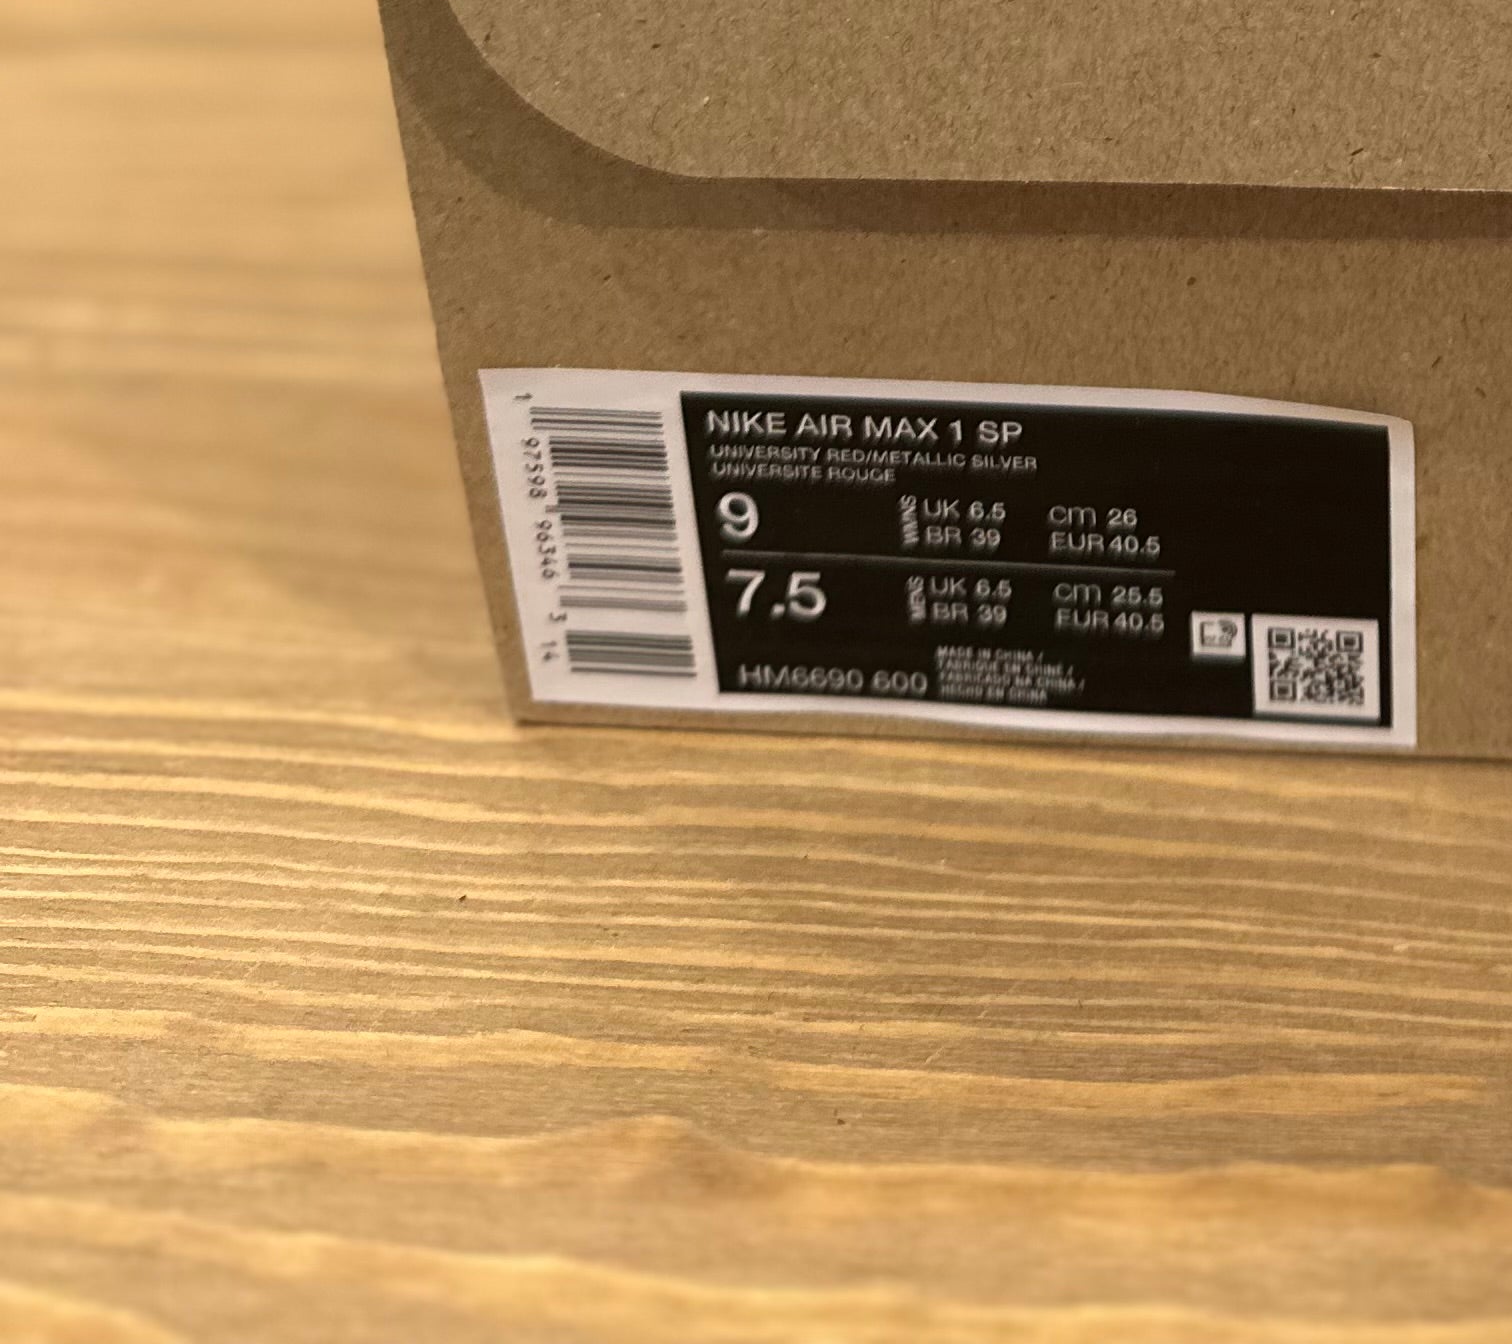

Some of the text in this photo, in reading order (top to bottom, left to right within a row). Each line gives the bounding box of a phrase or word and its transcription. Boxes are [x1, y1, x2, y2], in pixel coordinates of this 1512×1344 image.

[707, 410, 1023, 443] NIKE AIR MAX 1 SP
[522, 438, 547, 499] 97598
[709, 444, 1037, 469] UNIVERSITY RED/METALLIC SILVER
[712, 462, 896, 483] UNIVERSITE ROUGE
[718, 492, 759, 540] 9
[924, 498, 1006, 522] UK 6.5
[1107, 508, 1138, 527] 26
[925, 526, 1001, 547] BR 39
[1051, 532, 1161, 555] EUR 40.5
[727, 569, 827, 617] 7.5
[930, 576, 1012, 599] UK 6.5
[1111, 585, 1163, 606] 25.5
[932, 602, 1008, 624] BR 39
[1056, 608, 1164, 632] EUR 40.5
[739, 664, 927, 694] HM6690 600
